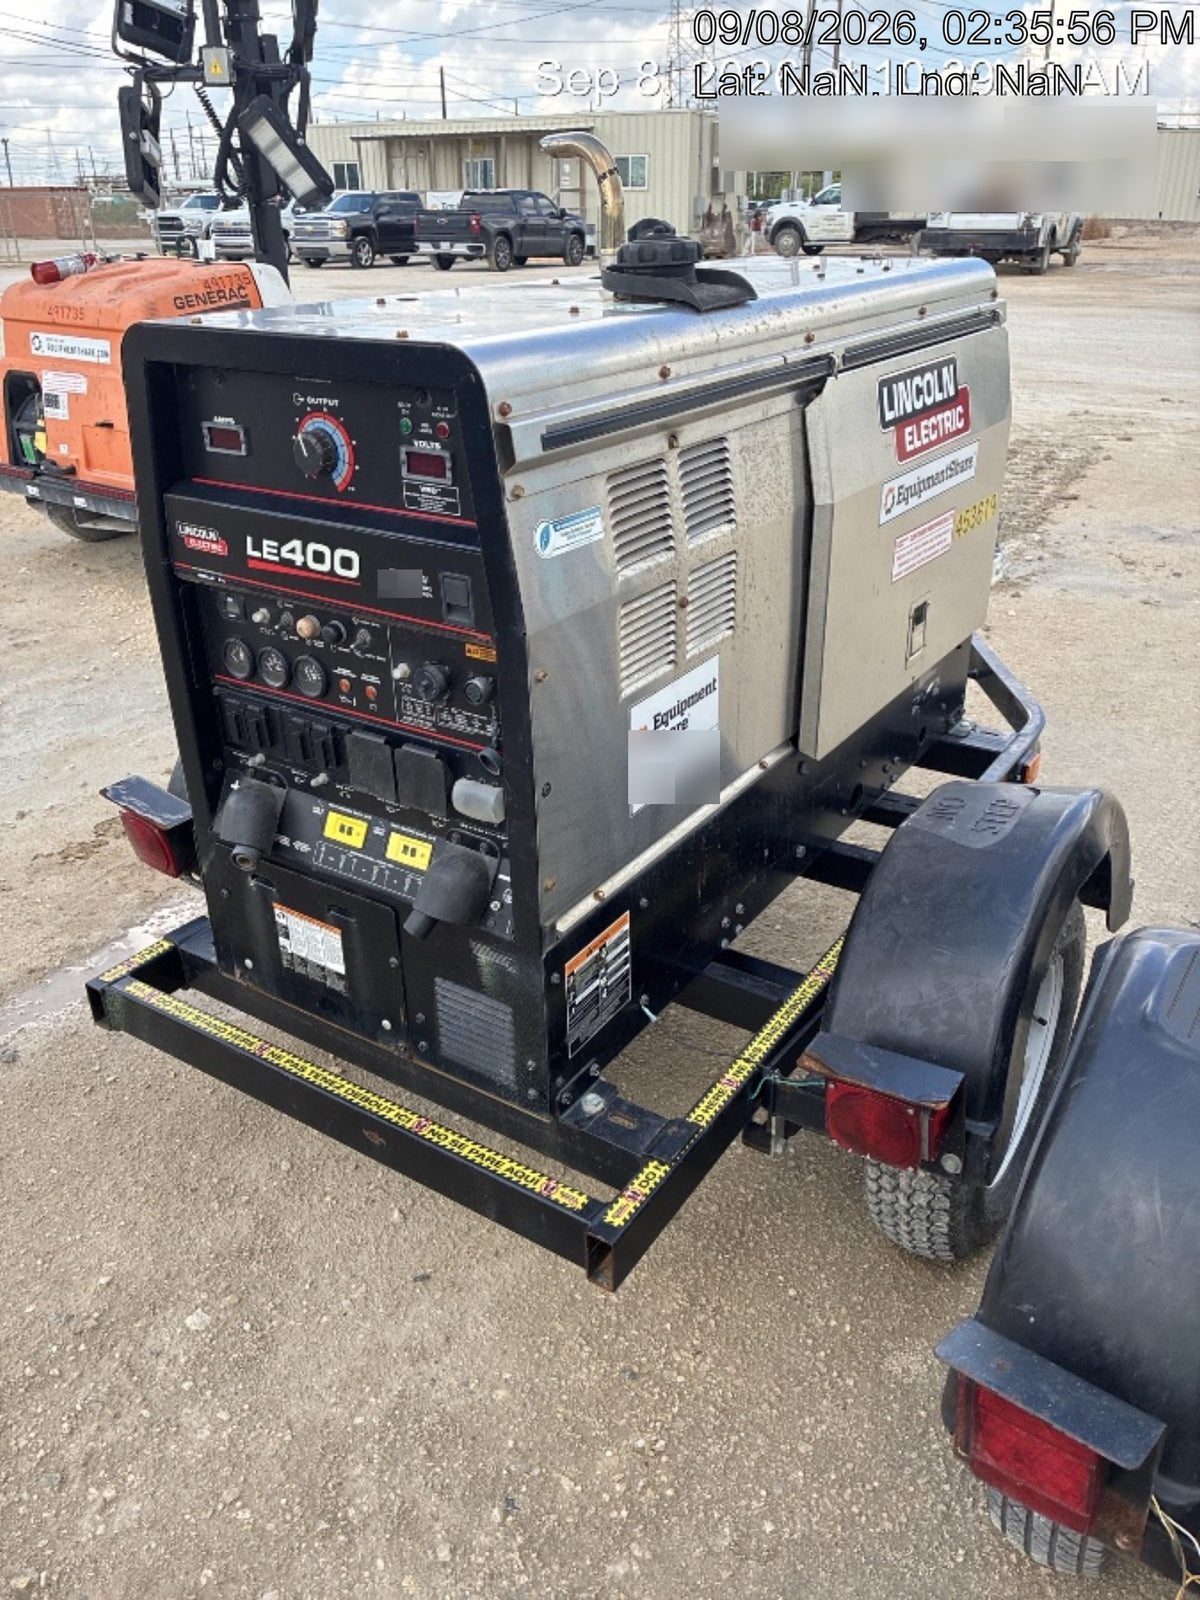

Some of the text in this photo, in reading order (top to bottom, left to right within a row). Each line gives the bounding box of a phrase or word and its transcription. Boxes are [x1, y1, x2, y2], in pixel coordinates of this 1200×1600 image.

[173, 285, 249, 311] GENERAC
[882, 363, 956, 422] LINCOLN
[904, 405, 965, 453] ELECTRIC
[896, 457, 974, 506] EquipmentShare
[246, 534, 361, 579] LE400
[653, 676, 718, 731] Equipment
[927, 797, 967, 821] NO
[971, 799, 1020, 835] STEP
[428, 1127, 449, 1142] NO
[450, 1136, 468, 1151] SE
[468, 1145, 503, 1168] PARE
